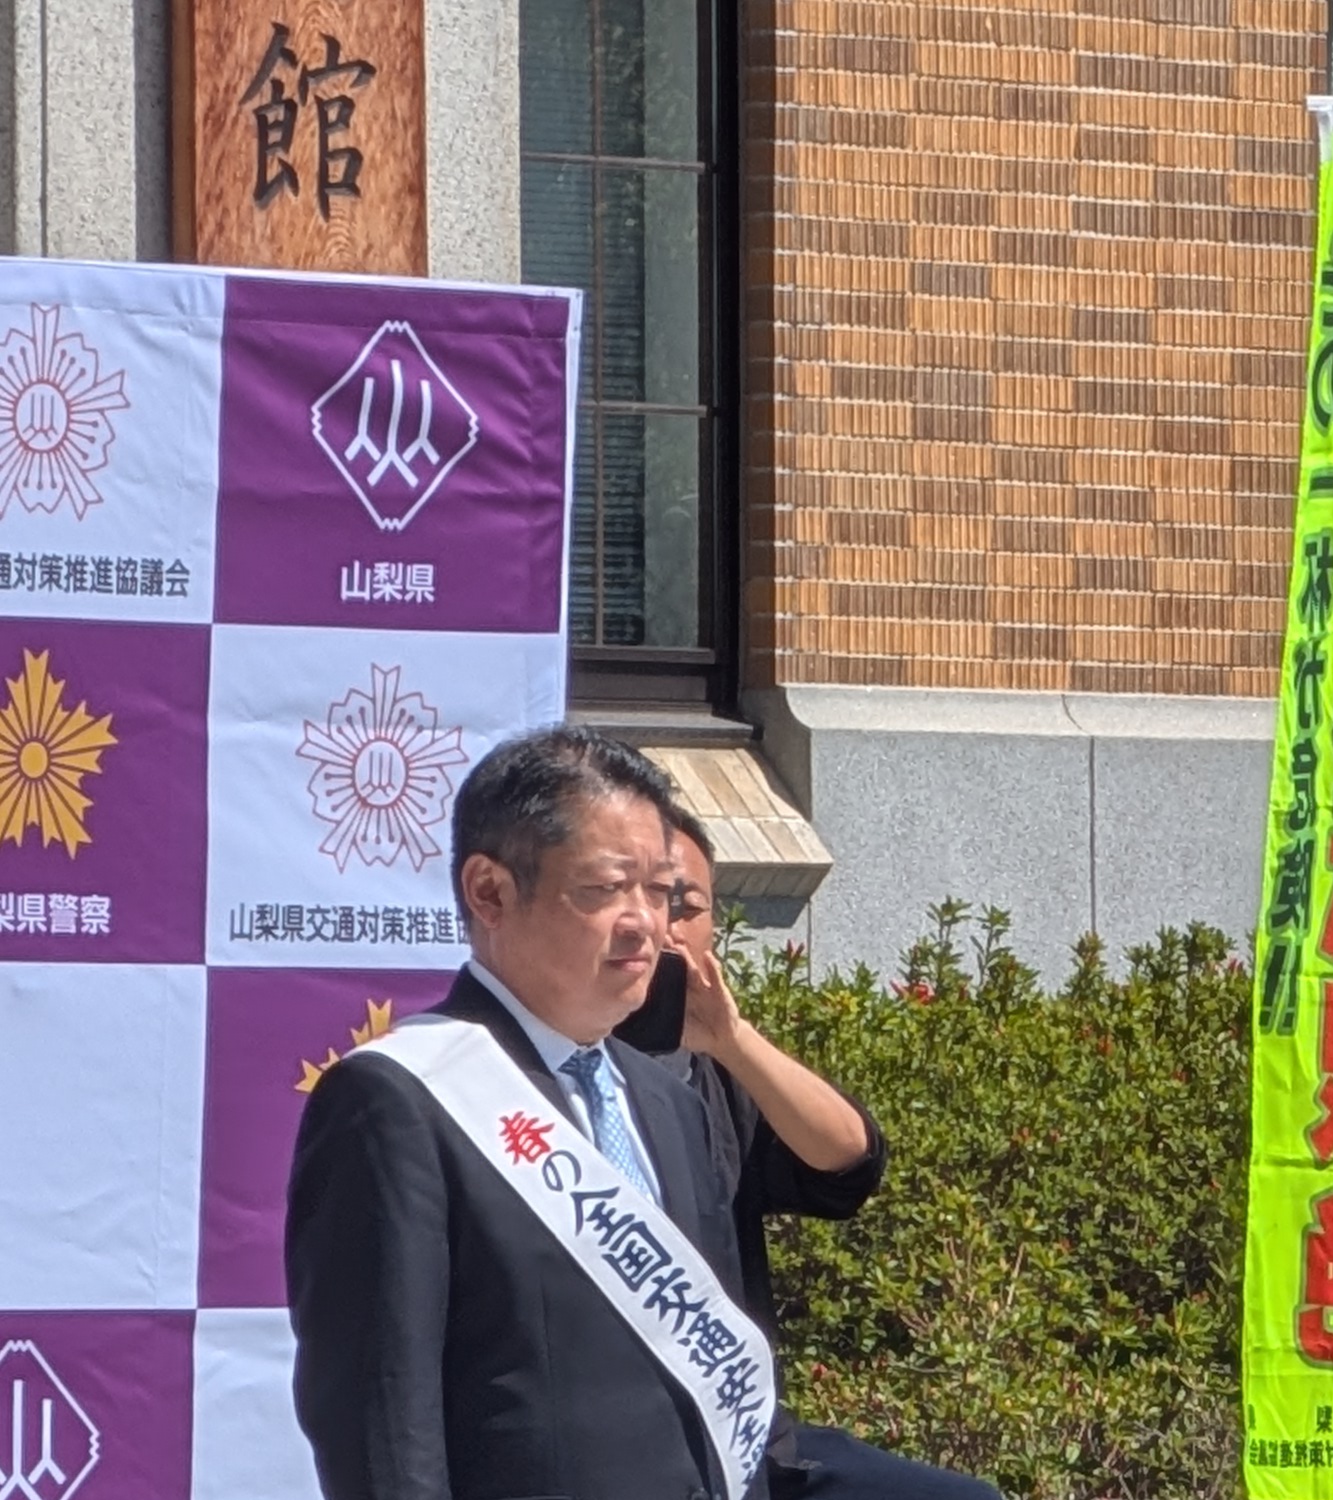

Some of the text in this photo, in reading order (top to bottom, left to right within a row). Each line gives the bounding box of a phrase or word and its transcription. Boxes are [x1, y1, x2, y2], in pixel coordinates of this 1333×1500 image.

[239, 22, 376, 219] 館
[341, 560, 436, 602] 山梨県
